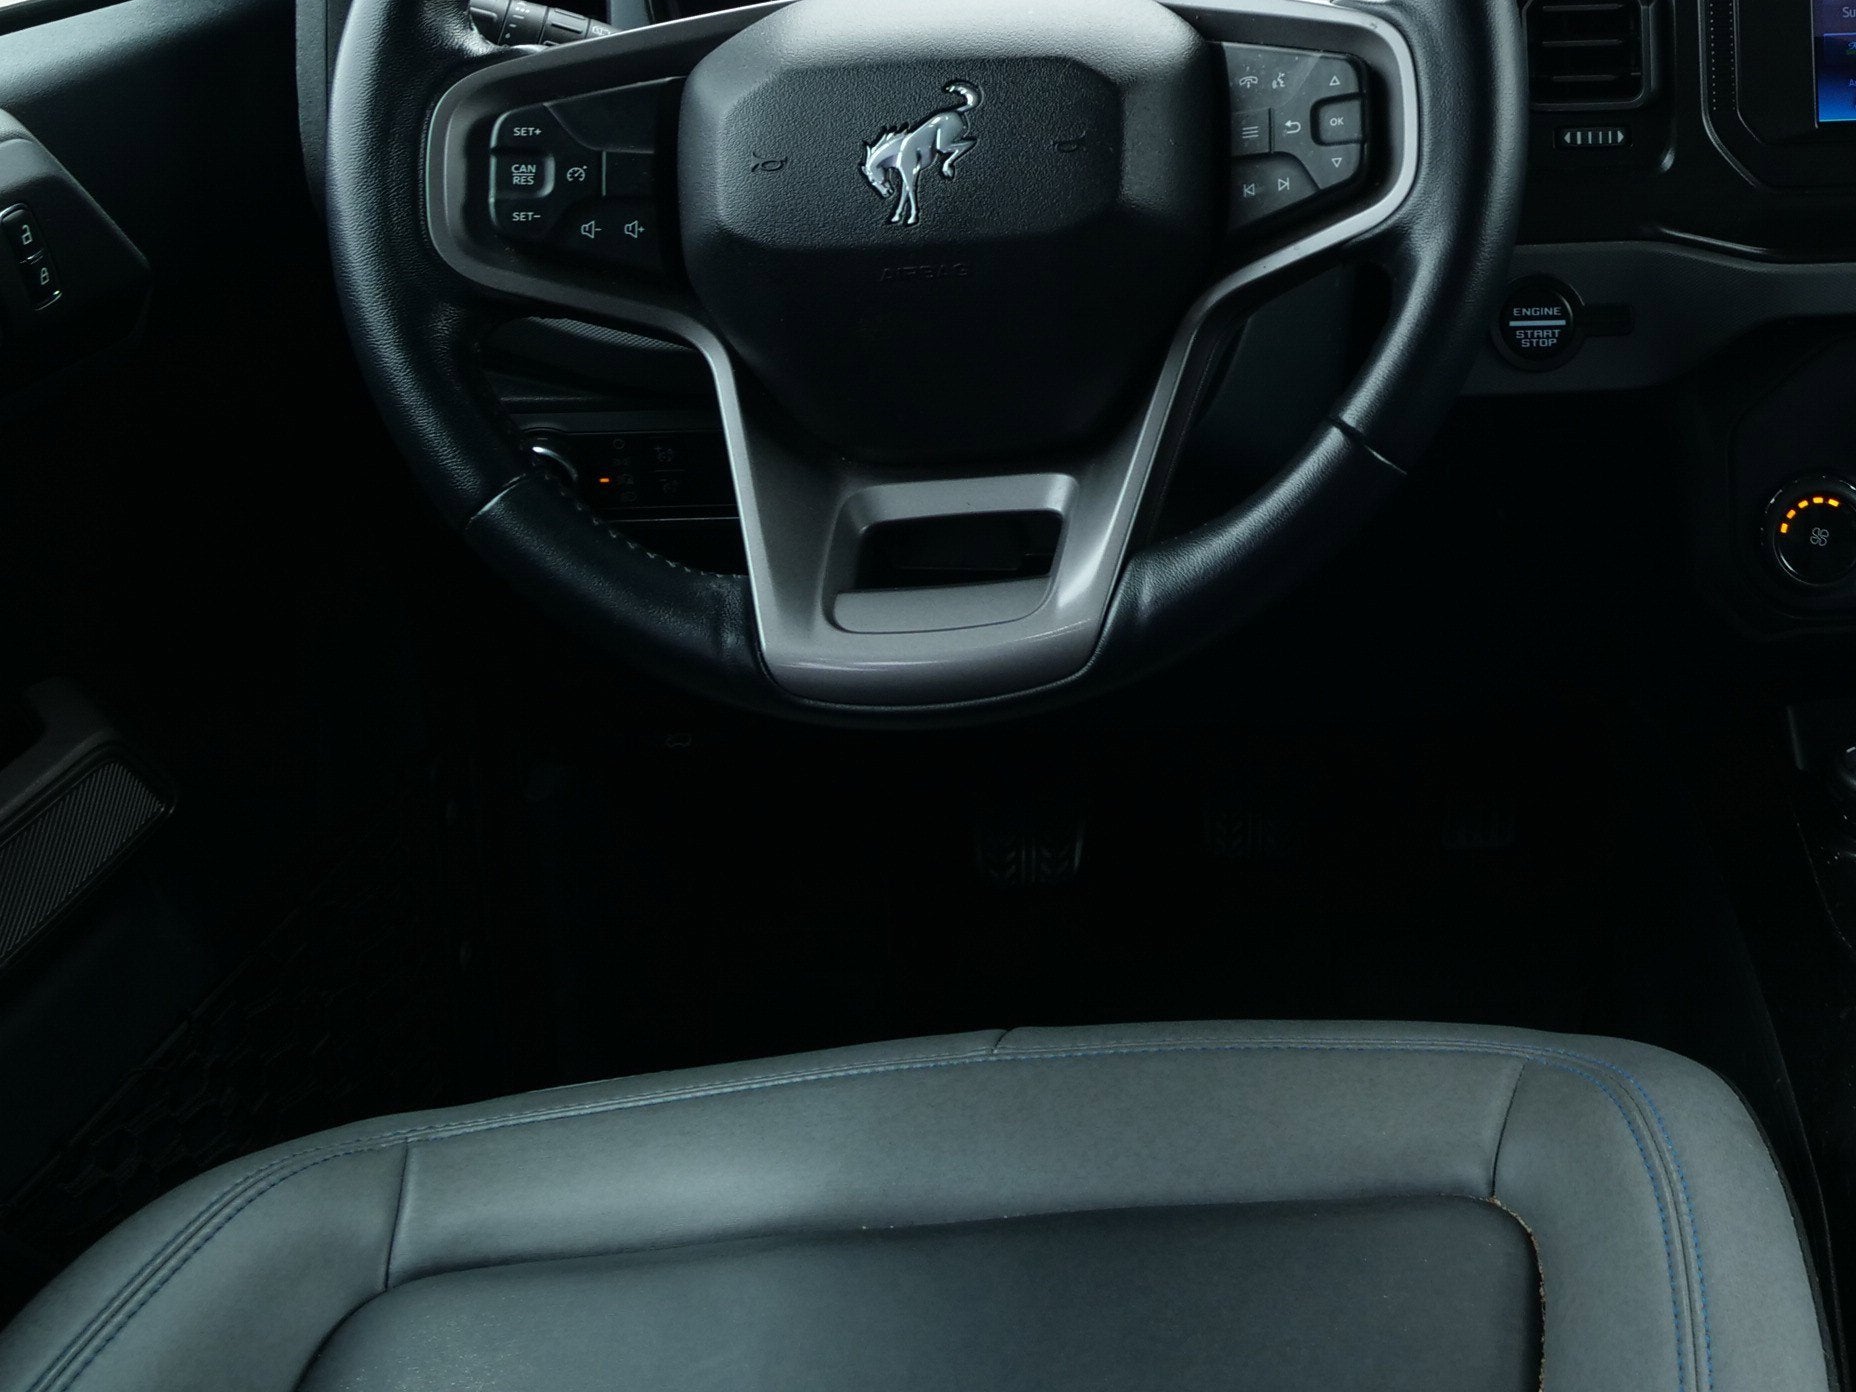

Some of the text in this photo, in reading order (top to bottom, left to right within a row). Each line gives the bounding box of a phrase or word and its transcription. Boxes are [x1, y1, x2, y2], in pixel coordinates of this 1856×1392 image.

[1330, 117, 1344, 126] OK
[513, 127, 542, 137] SET+
[511, 164, 536, 173] CAN
[512, 176, 535, 185] RES
[1513, 307, 1562, 316] ENGINE
[1516, 329, 1561, 338] START
[1521, 338, 1557, 347] STOP
